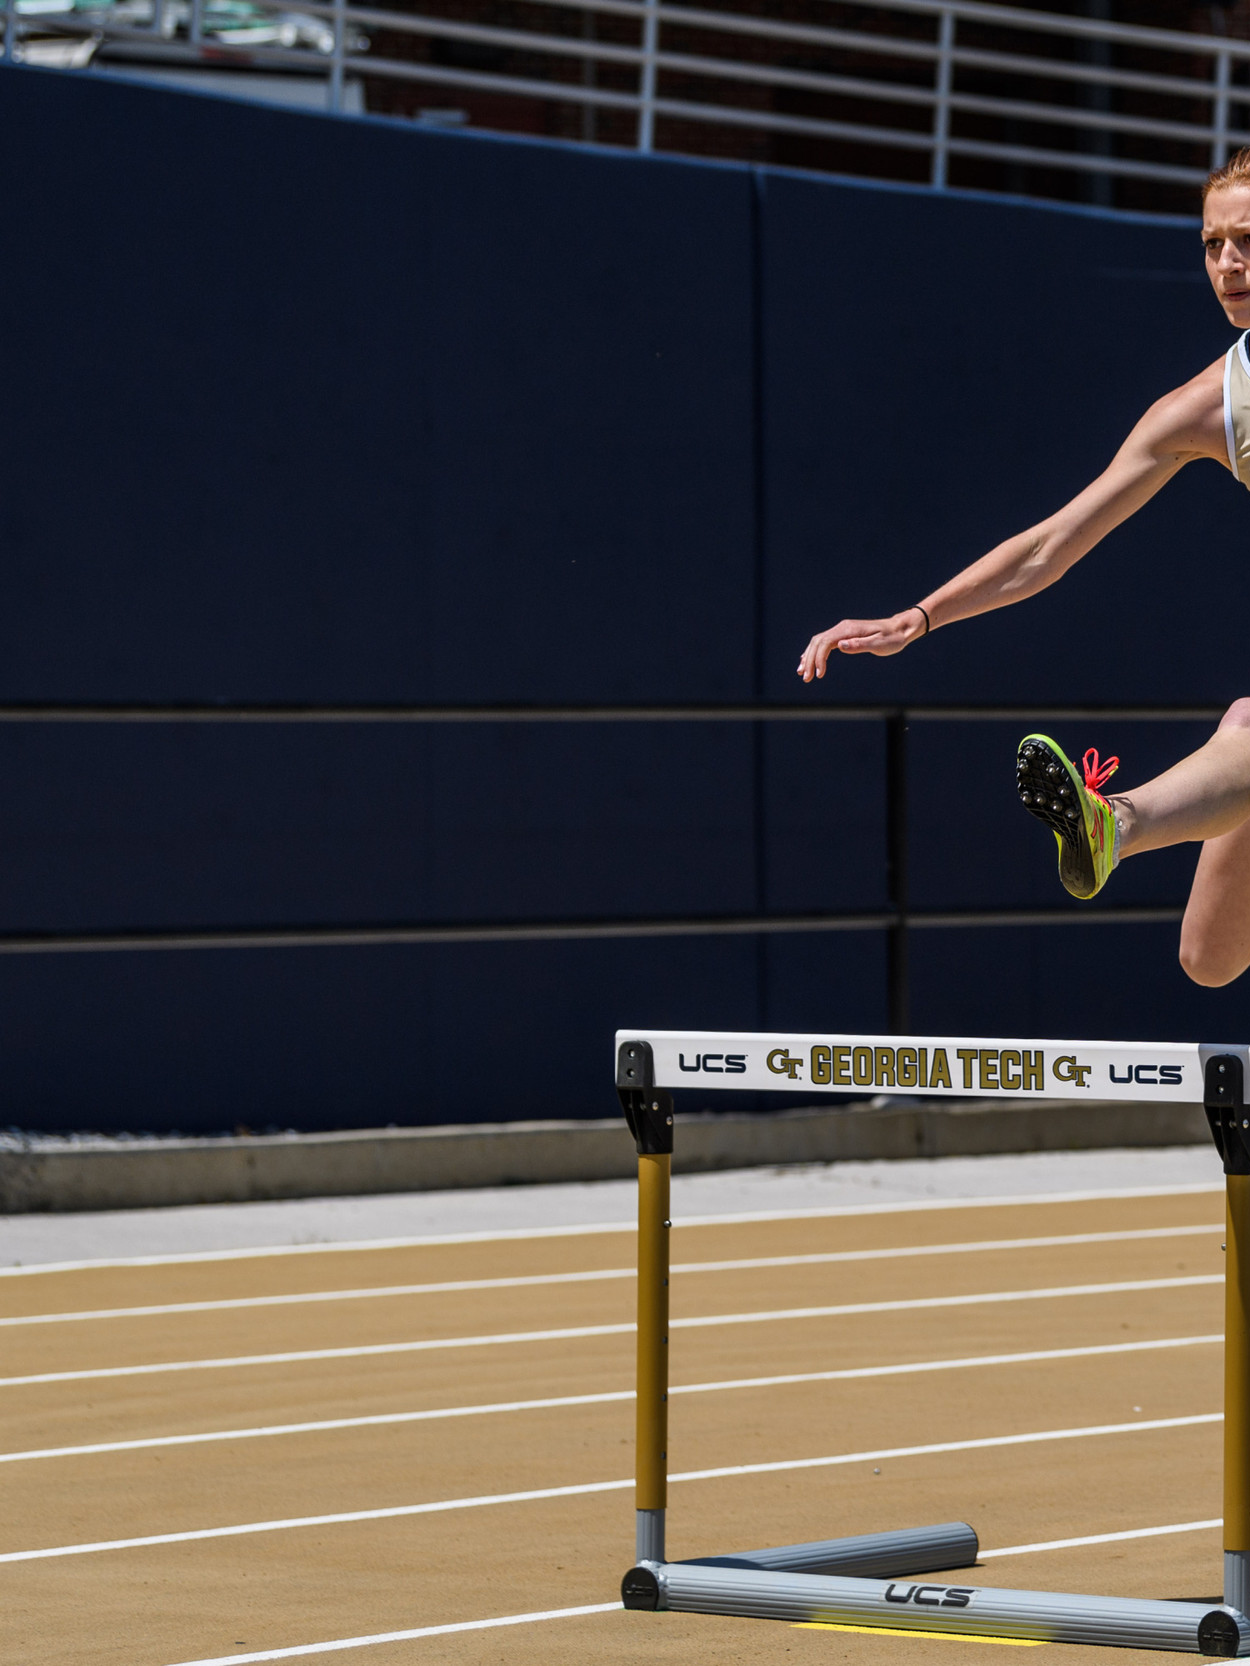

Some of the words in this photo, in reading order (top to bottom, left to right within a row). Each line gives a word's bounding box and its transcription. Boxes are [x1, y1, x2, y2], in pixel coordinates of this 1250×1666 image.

[678, 1053, 747, 1073] UCS
[766, 1048, 804, 1079] GT
[810, 1045, 952, 1088] GEORGIA
[957, 1048, 1044, 1091] TECH
[1052, 1055, 1091, 1087] GT
[1109, 1064, 1183, 1085] UCS
[885, 1584, 976, 1608] UCS
